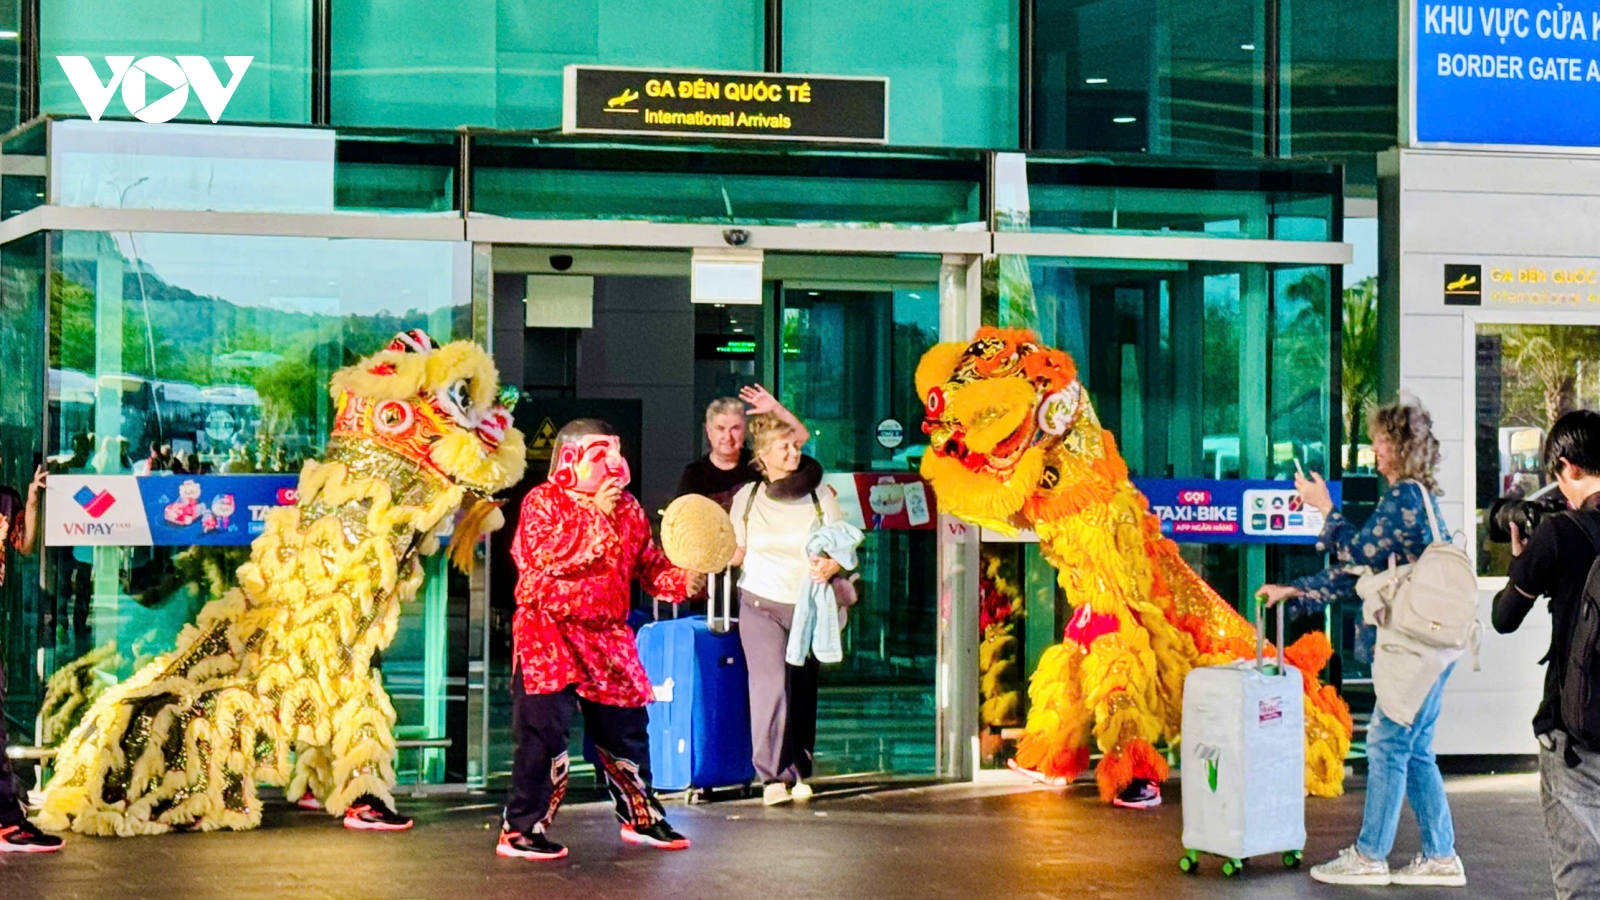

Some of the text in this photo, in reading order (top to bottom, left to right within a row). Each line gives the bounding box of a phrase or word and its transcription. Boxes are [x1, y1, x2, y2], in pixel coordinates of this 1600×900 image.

[1425, 4, 1473, 36] KHU
[1479, 7, 1530, 45] VỰC
[1535, 2, 1587, 41] CỬA
[1437, 53, 1524, 80] BORDER
[1528, 56, 1582, 82] GATE
[645, 80, 675, 98] GA
[645, 108, 791, 128] International Arrivals
[1490, 267, 1514, 283] GA
[63, 522, 114, 535] VNPAY
